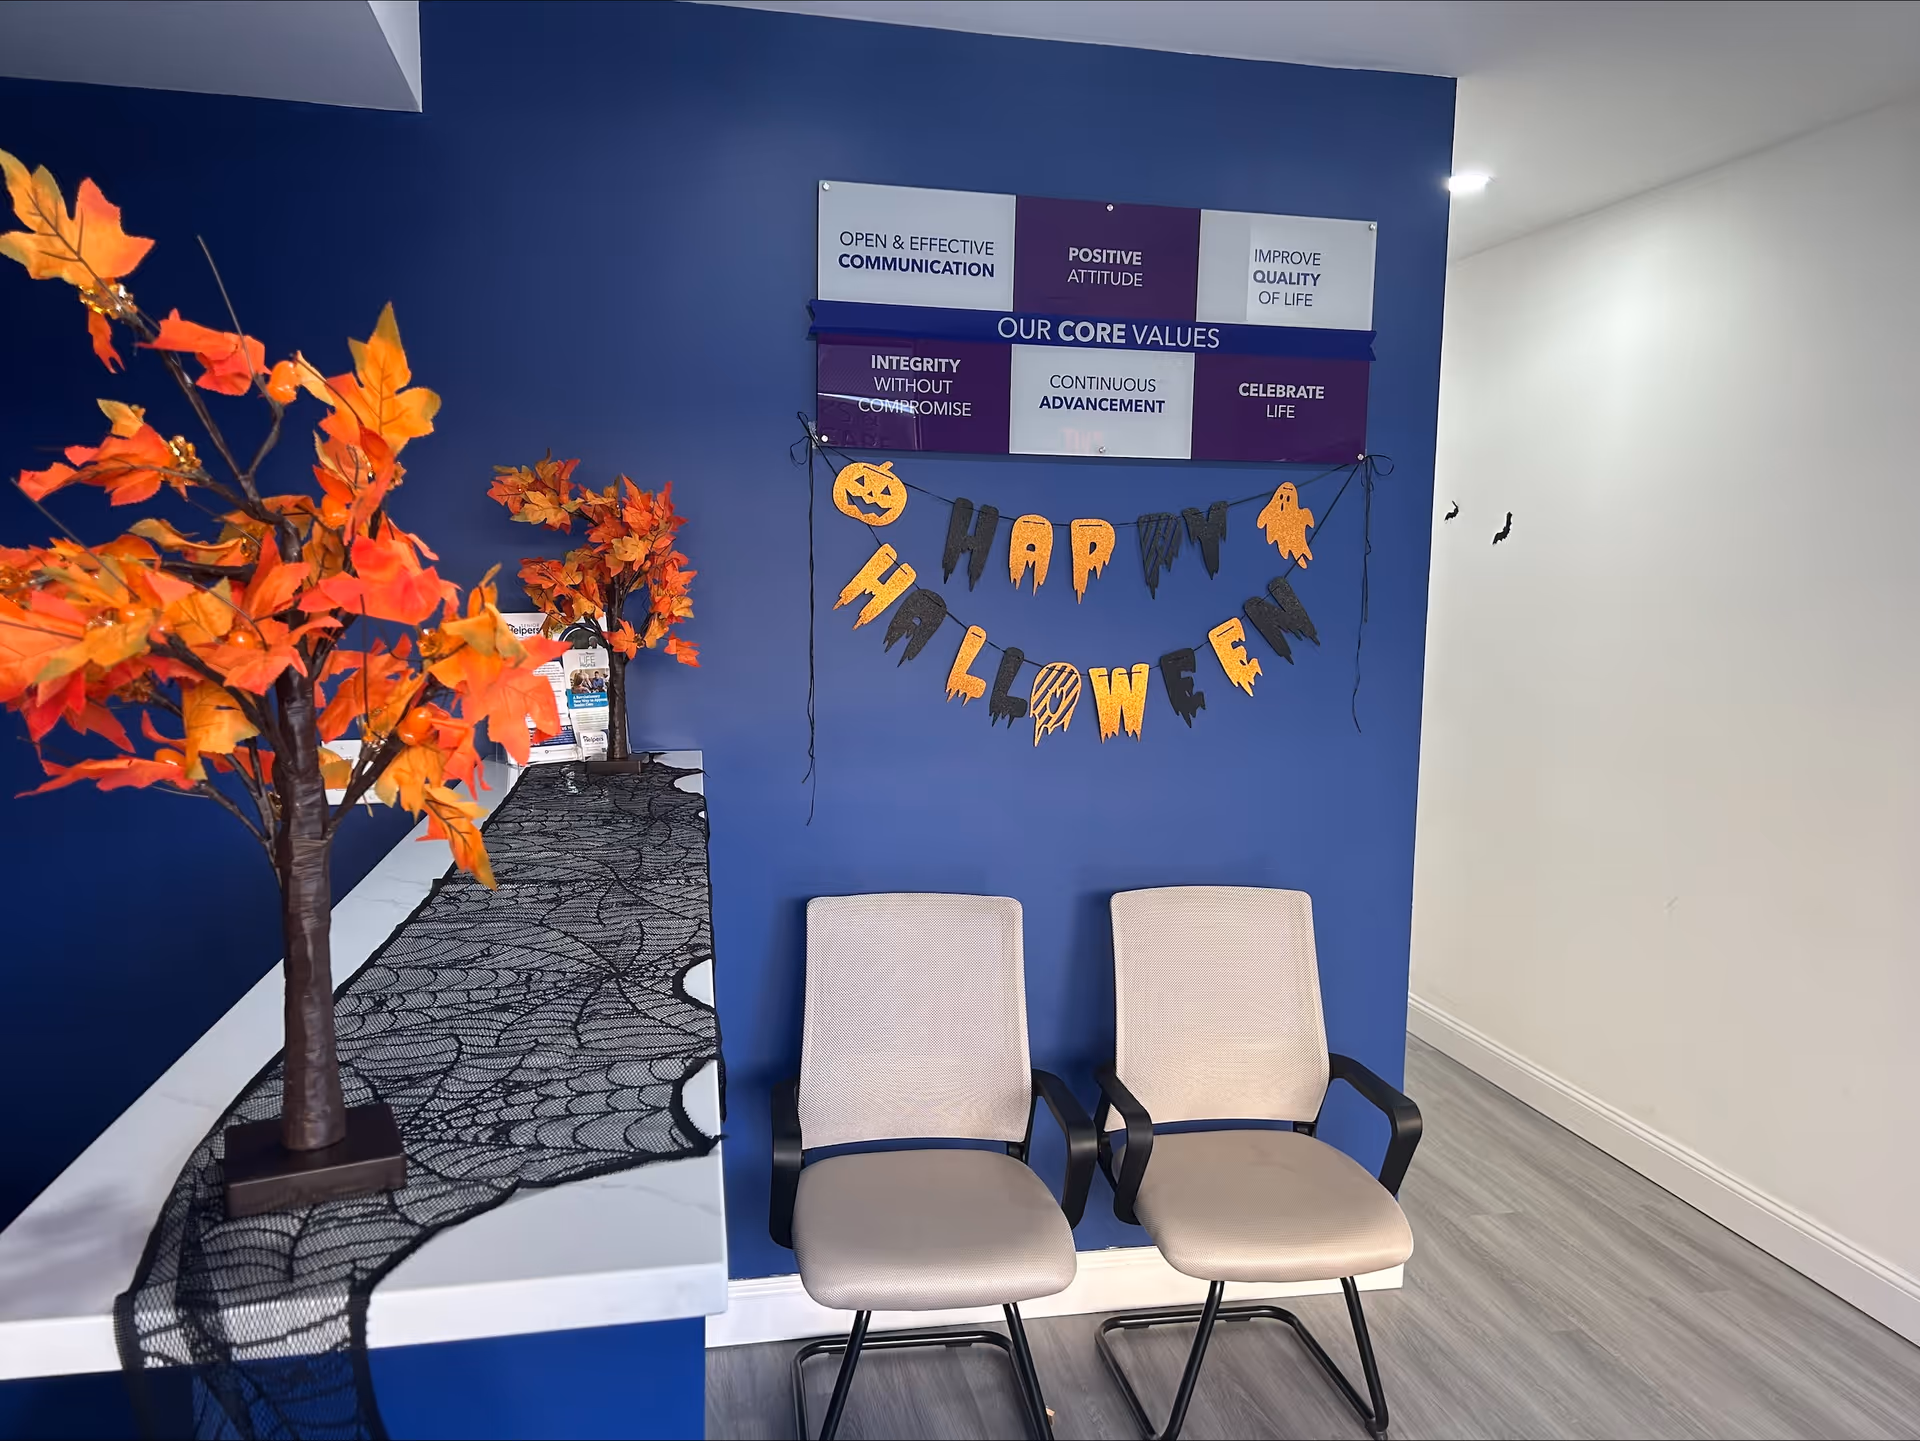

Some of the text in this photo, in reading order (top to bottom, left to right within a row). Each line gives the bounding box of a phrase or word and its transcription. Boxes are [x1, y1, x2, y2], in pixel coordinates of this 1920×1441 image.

[840, 231, 994, 256] OPEN & EFFECTIVE
[838, 253, 995, 278] COMMUNICATION
[1068, 247, 1142, 266] POSITIVE
[1254, 249, 1321, 266] IMPROVE
[1067, 269, 1143, 287] ATTITUDE
[1253, 270, 1321, 287] QUALITY
[1258, 291, 1313, 307] OF LIFE
[997, 317, 1220, 348] OUR CORE VALUES
[871, 354, 961, 373] INTEGRITY
[874, 376, 953, 394] WITHOUT
[1050, 374, 1156, 392] CONTINUOUS
[1238, 382, 1325, 399] CELEBRATE
[858, 397, 972, 417] COMPROMISE
[1039, 396, 1165, 413] ADVANCEMENT
[1266, 404, 1295, 419] LIFE
[942, 497, 1228, 604] HAPPY
[832, 542, 1321, 747] HALLOWEEN
